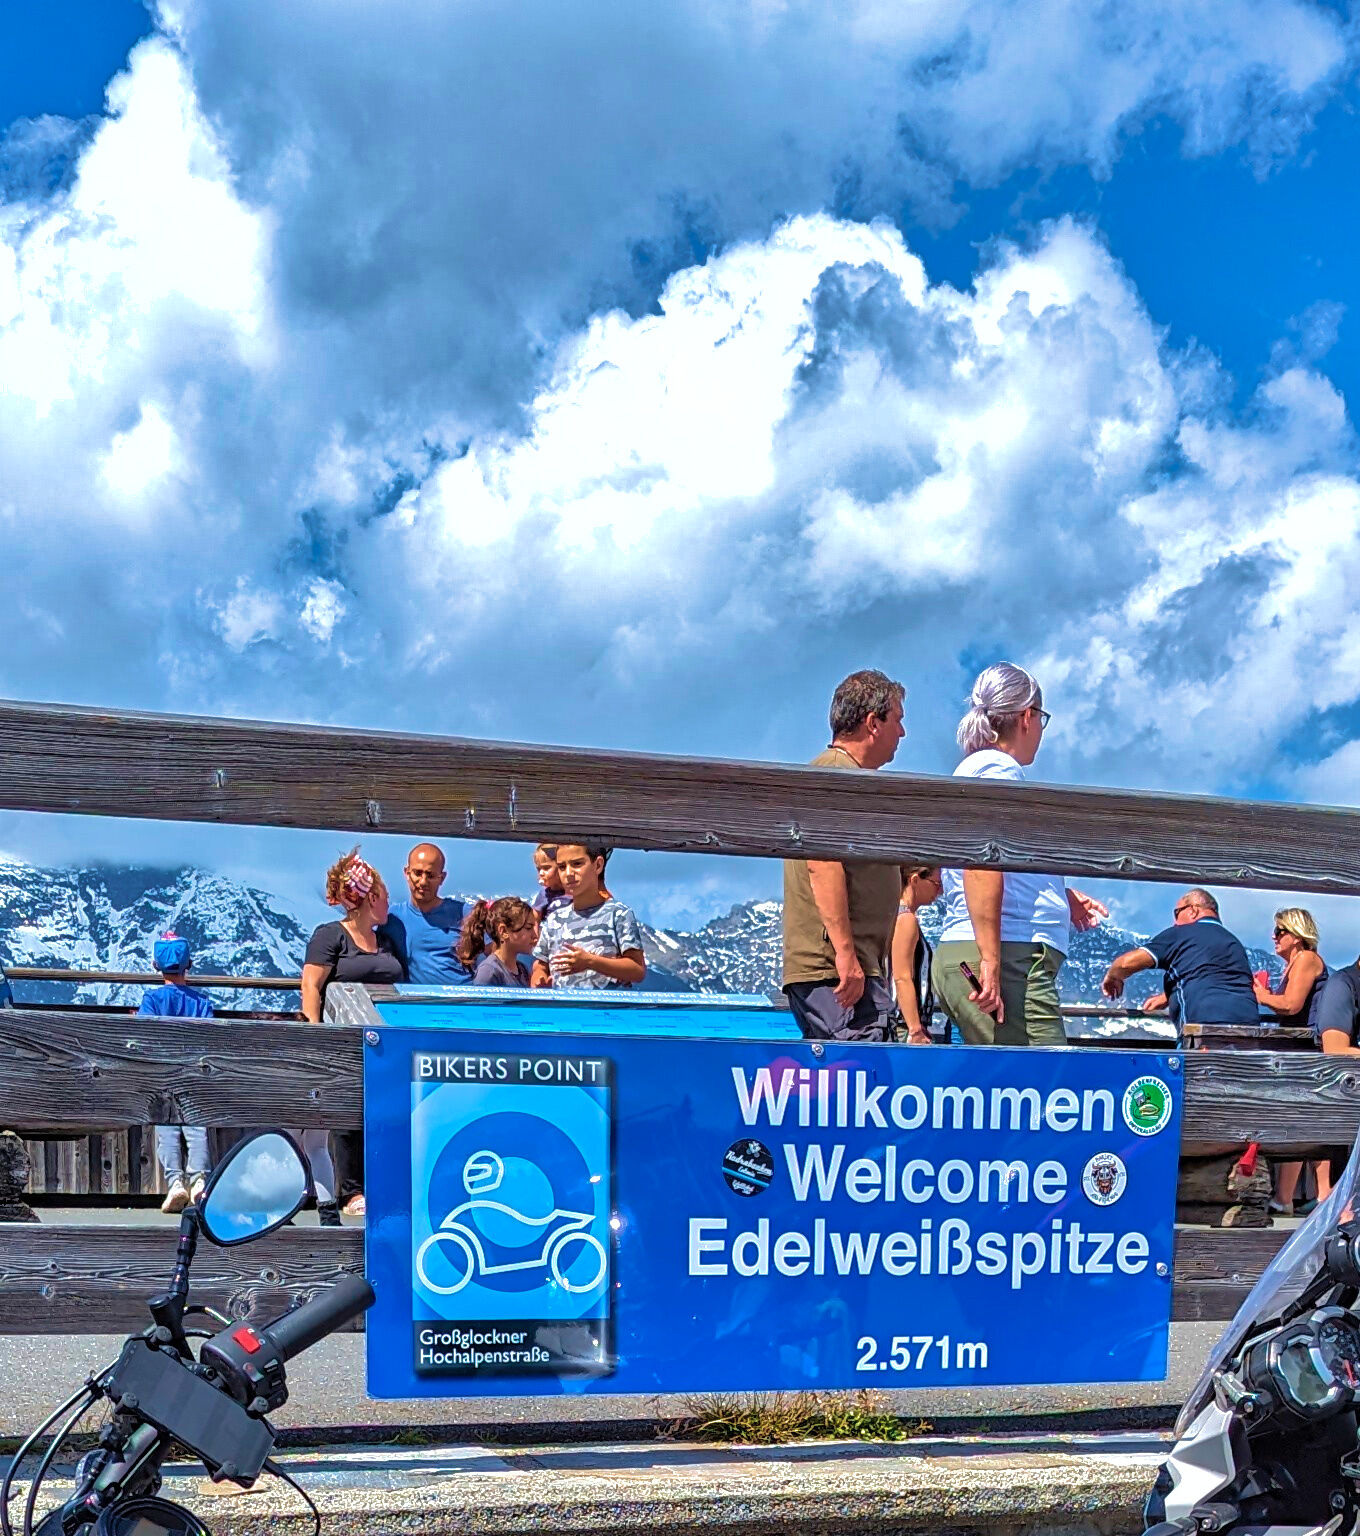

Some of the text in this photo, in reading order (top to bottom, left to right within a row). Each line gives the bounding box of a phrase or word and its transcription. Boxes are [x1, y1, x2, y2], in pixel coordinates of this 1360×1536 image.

[418, 1056, 601, 1083] BIKERS POINT
[731, 1066, 1115, 1131] Willkommen
[783, 1144, 1067, 1204] Welcome
[688, 1218, 1150, 1290] Edelweißspitze
[419, 1329, 528, 1349] Großglockner
[419, 1347, 550, 1368] Hochalpenstraße
[856, 1335, 989, 1373] 2.571m
